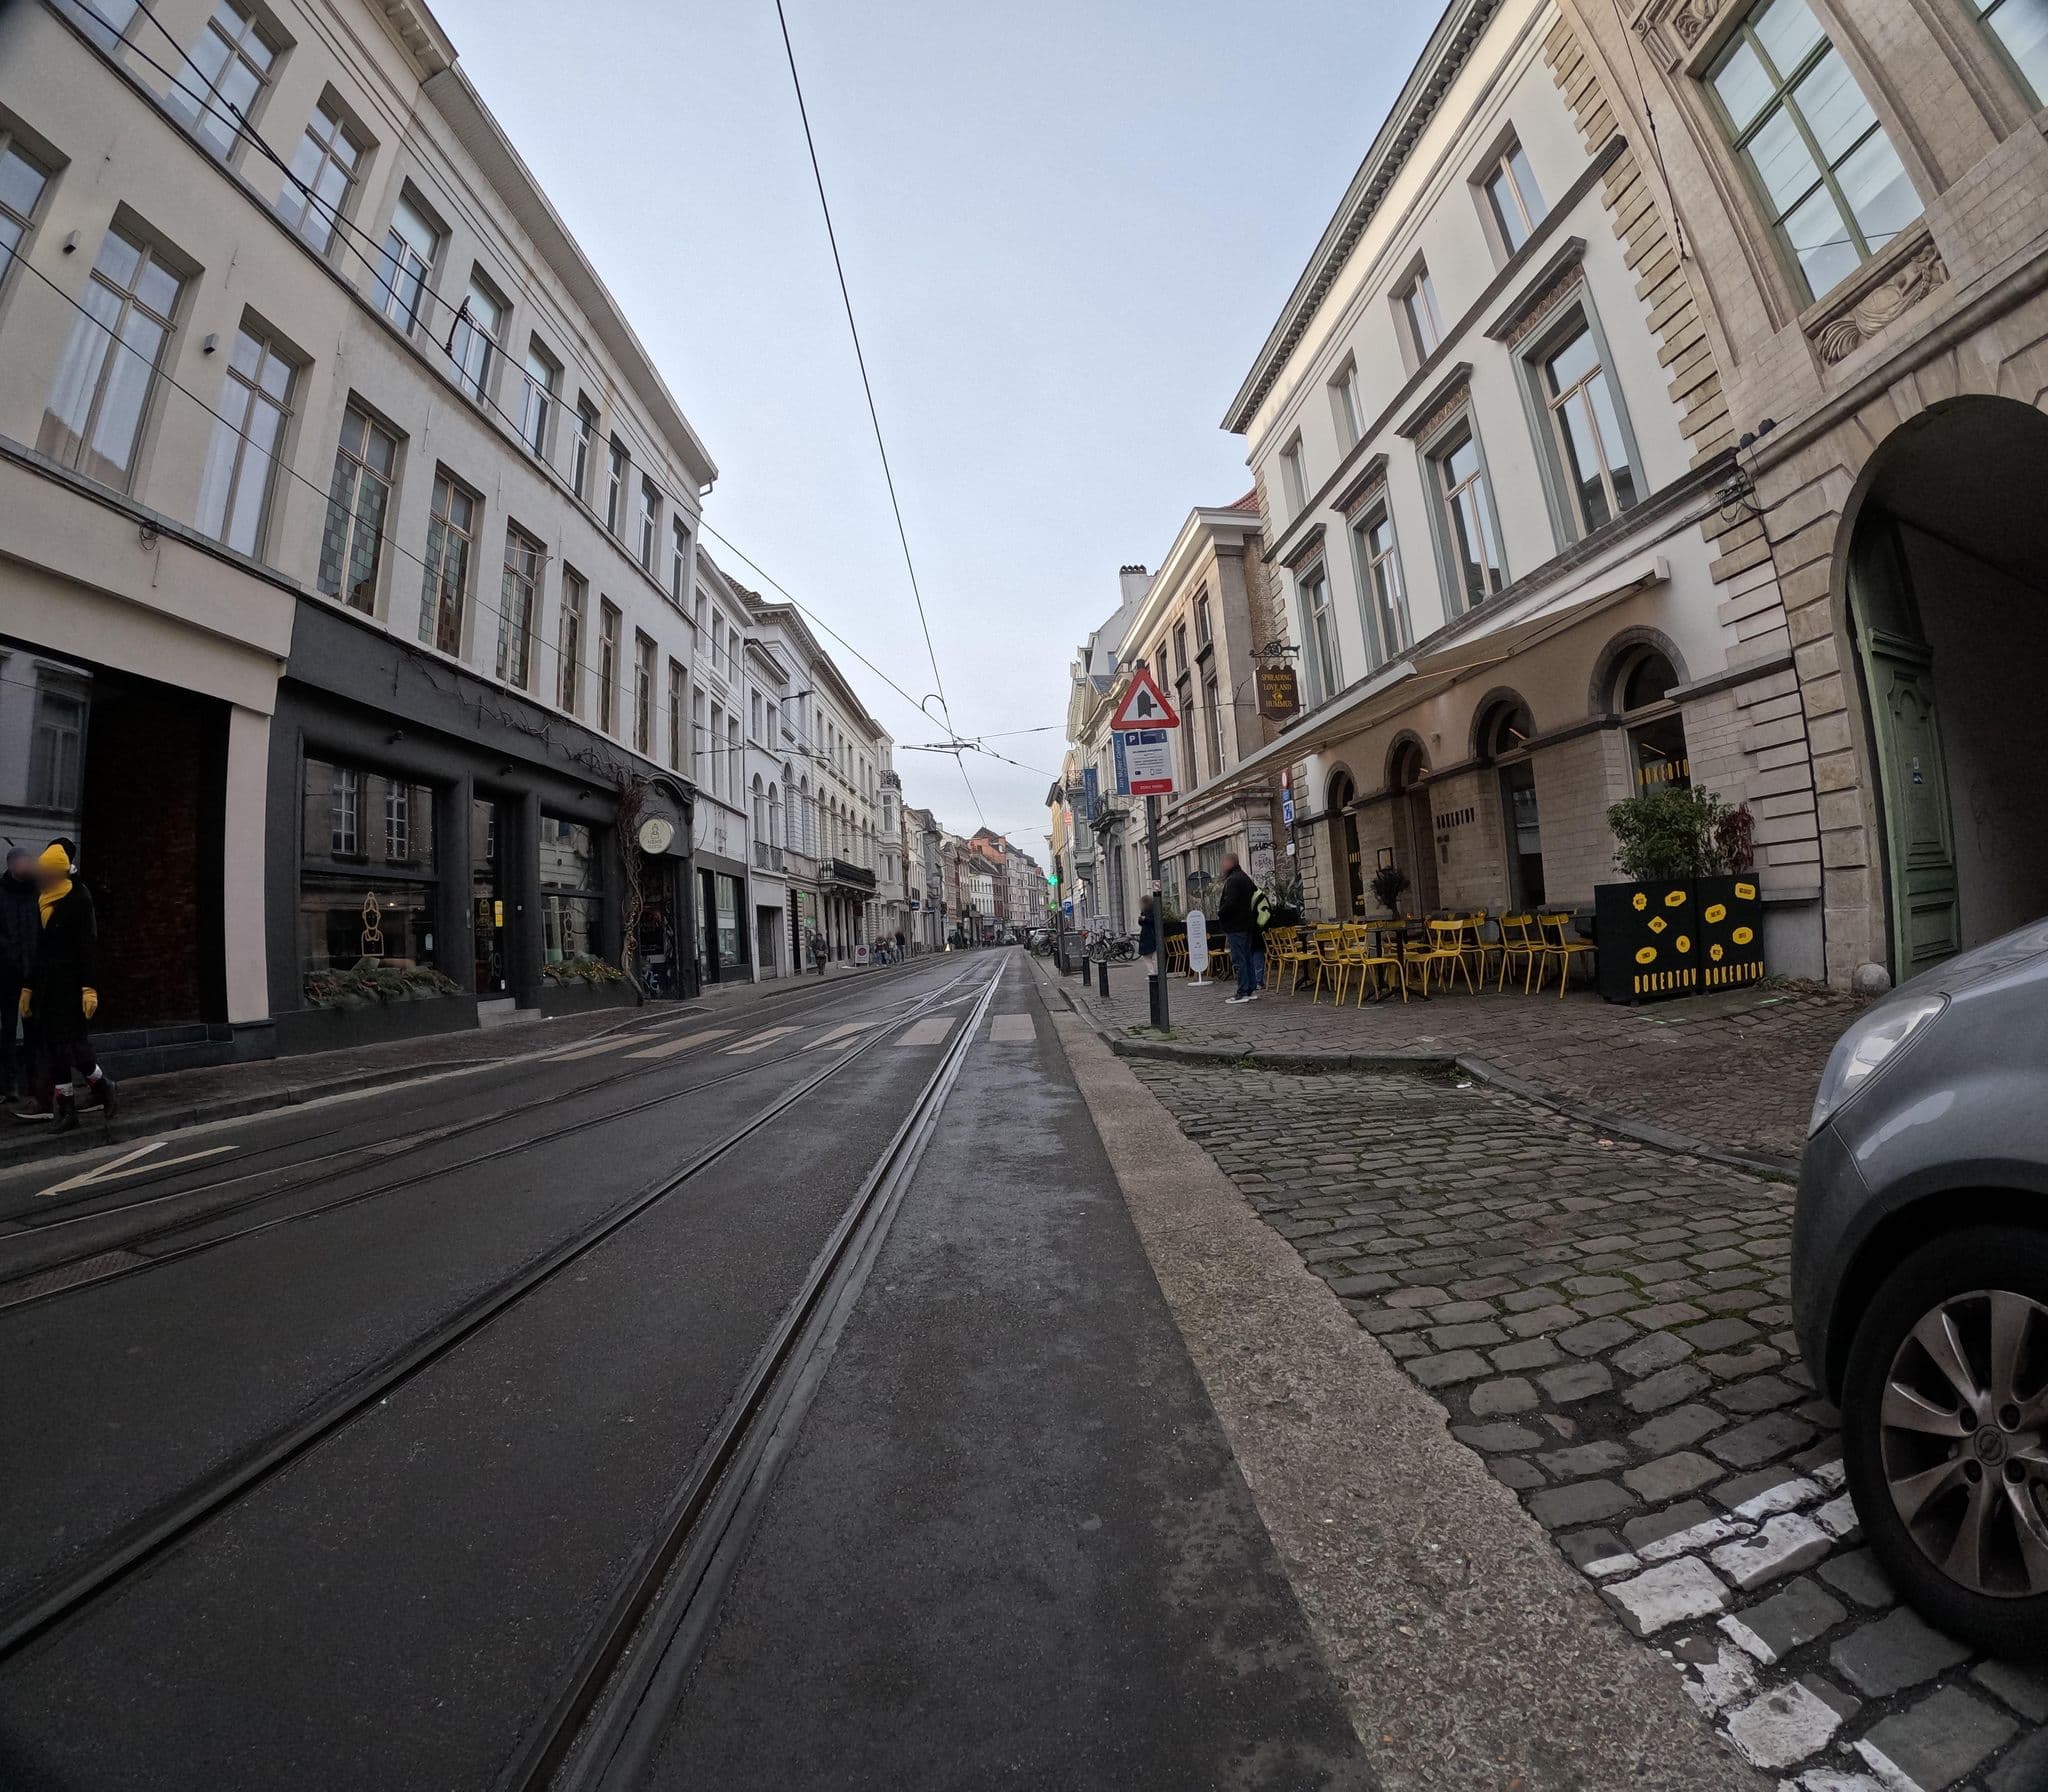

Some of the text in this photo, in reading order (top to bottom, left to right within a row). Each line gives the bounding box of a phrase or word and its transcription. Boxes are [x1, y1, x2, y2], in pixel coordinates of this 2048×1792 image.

[1261, 673, 1292, 681] SPREADING
[1263, 683, 1277, 691] LOVE
[1265, 700, 1293, 708] HUMMUS
[1129, 735, 1136, 743] P
[1436, 807, 1475, 830] BOKERTOV
[1705, 960, 1764, 986] BOKERTOV
[1634, 967, 1697, 994] BOKERTOV
